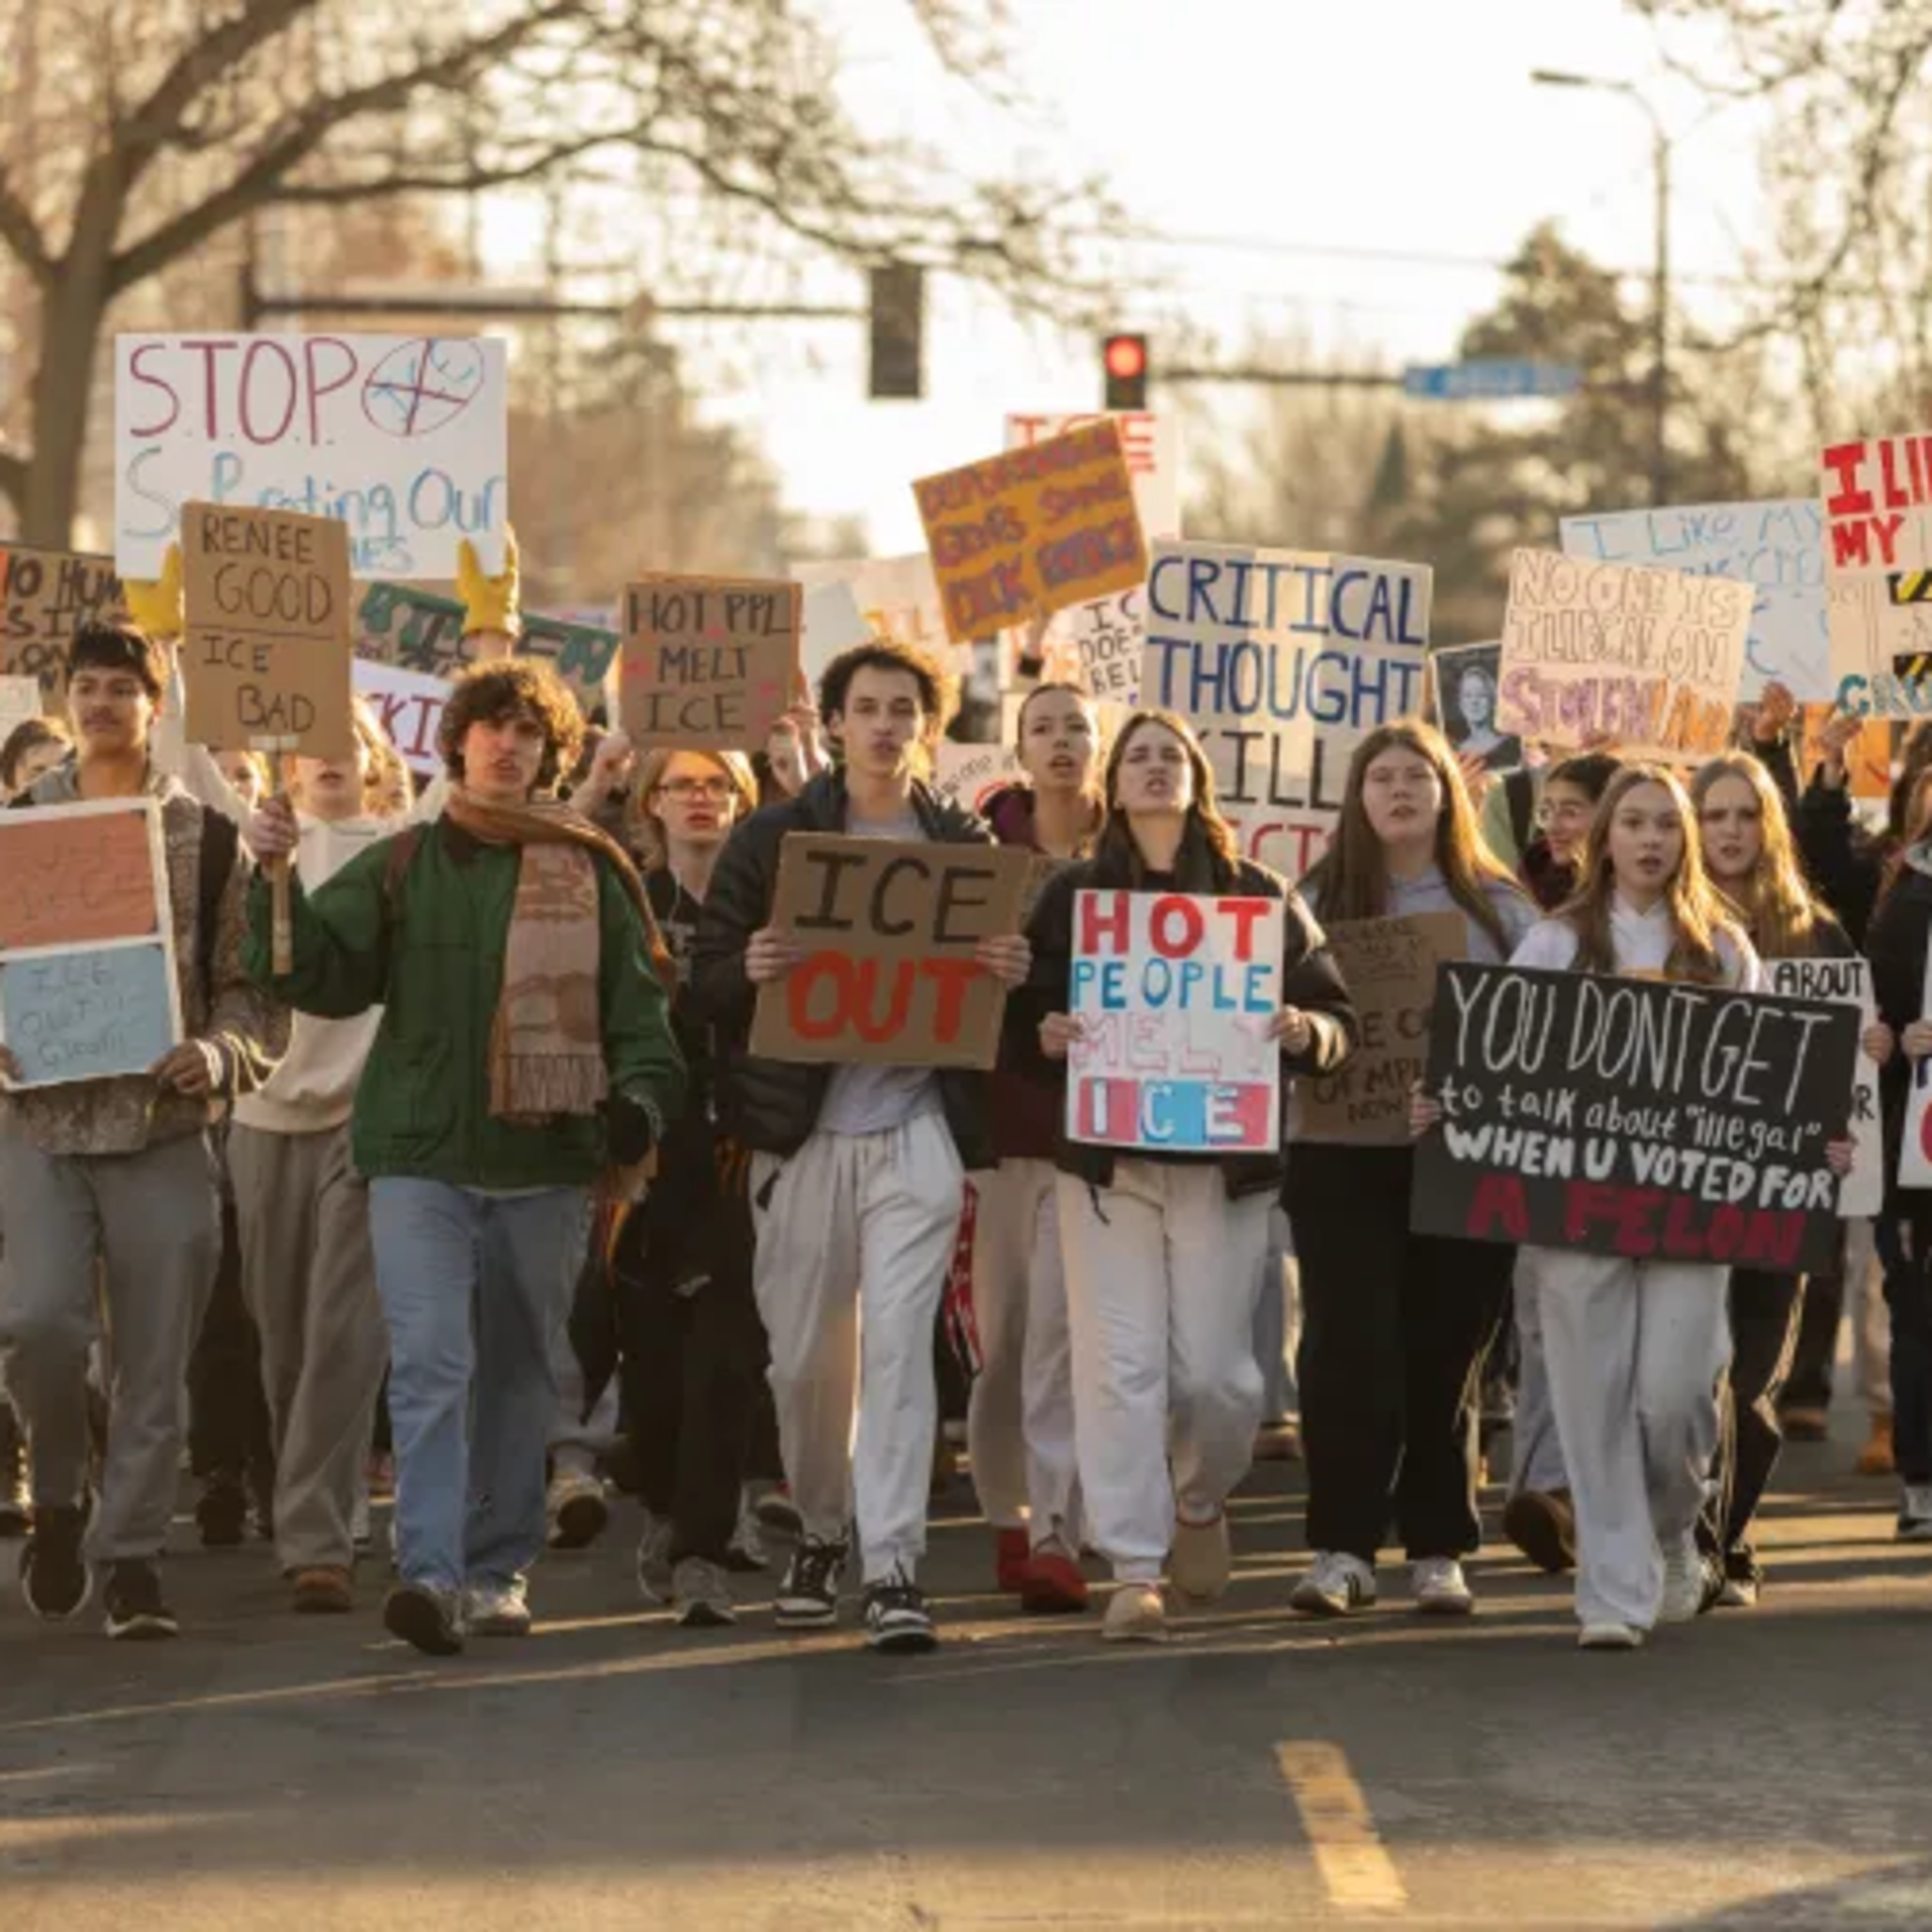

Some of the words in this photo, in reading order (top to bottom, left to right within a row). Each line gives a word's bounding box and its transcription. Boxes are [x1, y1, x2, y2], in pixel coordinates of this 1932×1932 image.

[408, 467, 505, 535] Our
[1824, 441, 1873, 516] I
[202, 515, 316, 565] RENEE
[1832, 513, 1904, 568] MY
[214, 562, 333, 625] GOOD
[629, 589, 704, 636] HOT
[724, 592, 793, 637] PPL
[1147, 554, 1425, 646] CRITICAL
[201, 634, 274, 674] ICE
[657, 643, 752, 686] MELT
[1146, 635, 1423, 728] THOUGHT
[236, 681, 316, 734] BAD
[641, 691, 746, 733] ICE
[1198, 729, 1346, 811] ILL
[794, 849, 996, 943] ICE
[1081, 890, 1272, 962] HOT
[786, 949, 989, 1044] OUT
[1072, 957, 1274, 1013] PEOPLE
[1774, 961, 1864, 999] ABOUT
[1069, 1012, 1273, 1075] MELT
[1447, 969, 1557, 1075] YOU
[1567, 978, 1710, 1094] DONT
[1700, 998, 1833, 1115] GET
[1090, 1076, 1247, 1144] ICE
[1438, 1073, 1482, 1117] to
[1584, 1094, 1678, 1140] about
[1443, 1121, 1577, 1179] WHEN
[1582, 1137, 1618, 1180] U
[1629, 1141, 1757, 1204] VOTED
[1758, 1164, 1833, 1209] FOR
[1466, 1173, 1530, 1242] A
[1562, 1178, 1807, 1265] FELON
